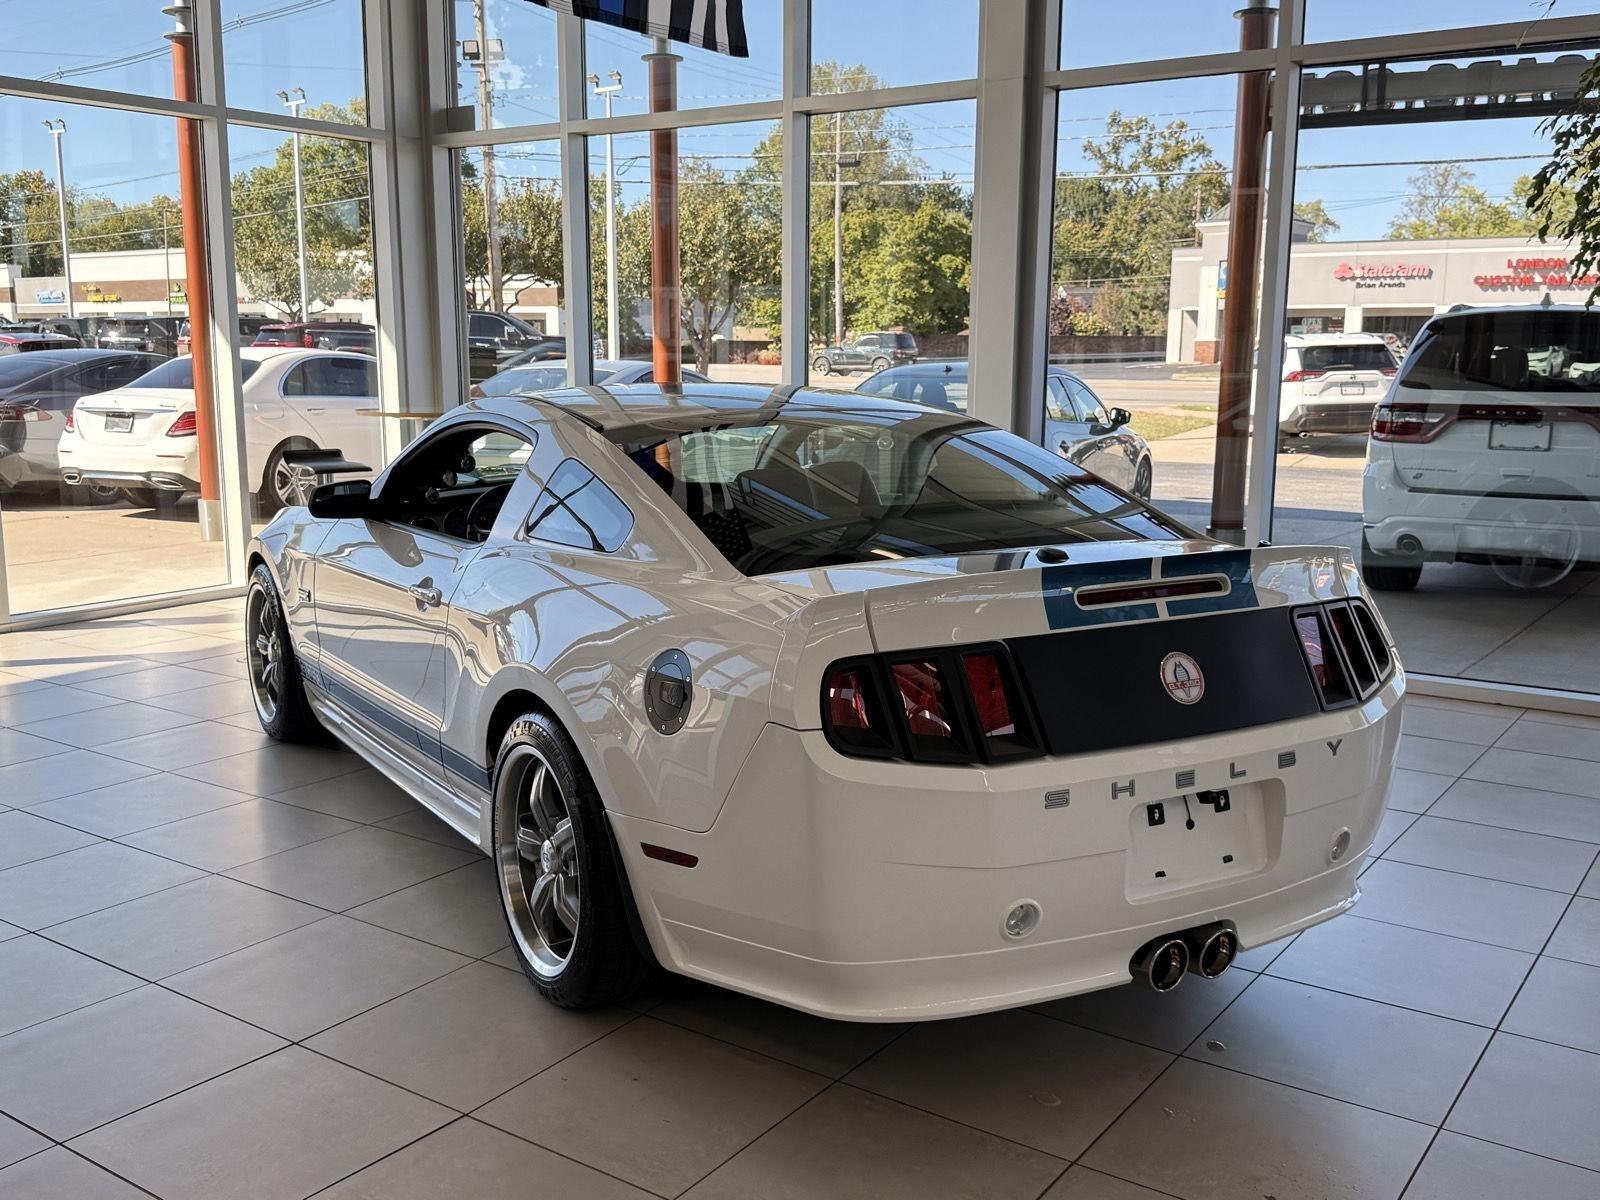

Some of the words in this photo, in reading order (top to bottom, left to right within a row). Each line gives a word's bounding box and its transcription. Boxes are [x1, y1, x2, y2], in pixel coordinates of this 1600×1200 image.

[1507, 257, 1567, 269] LONDON
[1474, 274, 1534, 286] CUSTOM
[1044, 738, 1342, 810] SHELBY
